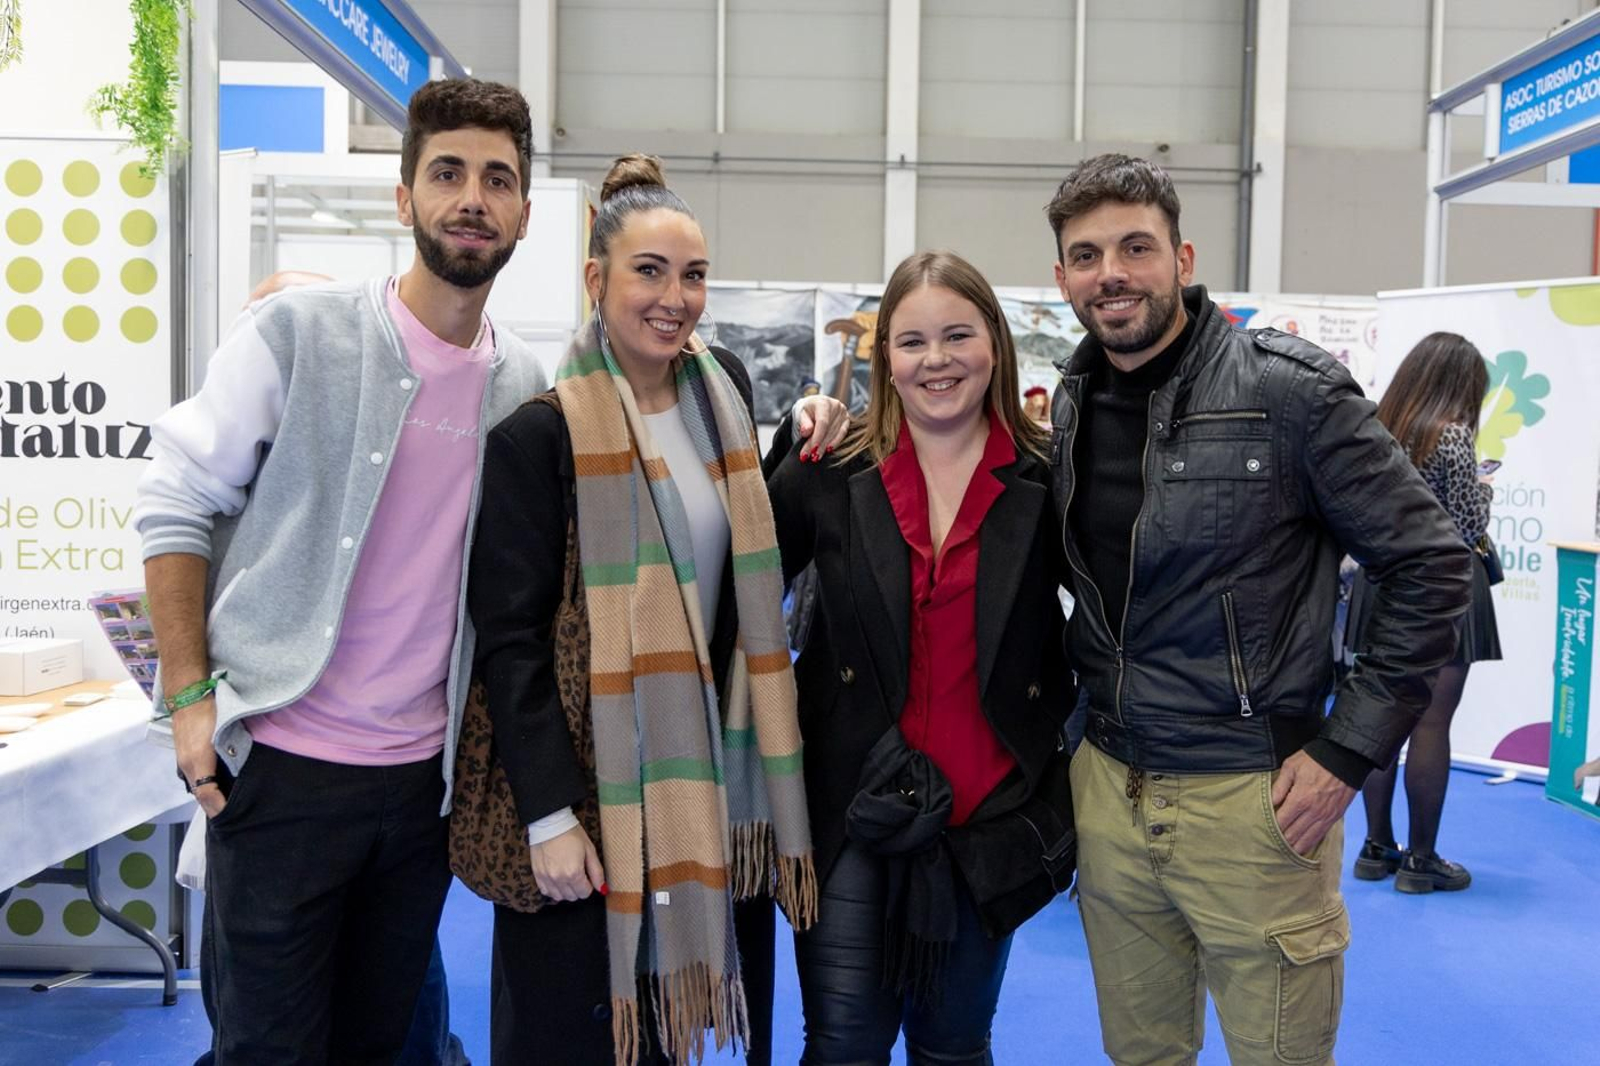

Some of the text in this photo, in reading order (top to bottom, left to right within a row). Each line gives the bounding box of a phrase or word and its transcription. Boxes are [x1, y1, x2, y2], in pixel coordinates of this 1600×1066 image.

[370, 23, 410, 85] JEWELRY
[1504, 51, 1600, 113] ASOC TURISMO SO
[1507, 78, 1600, 135] SIERRAS DE CAZO
[0, 371, 107, 415] nto
[435, 417, 480, 443] Angel
[1492, 481, 1546, 508] ción
[54, 497, 133, 529] Oliv
[1490, 515, 1543, 543] mo
[17, 539, 123, 571] Extra
[1500, 544, 1542, 573] ble
